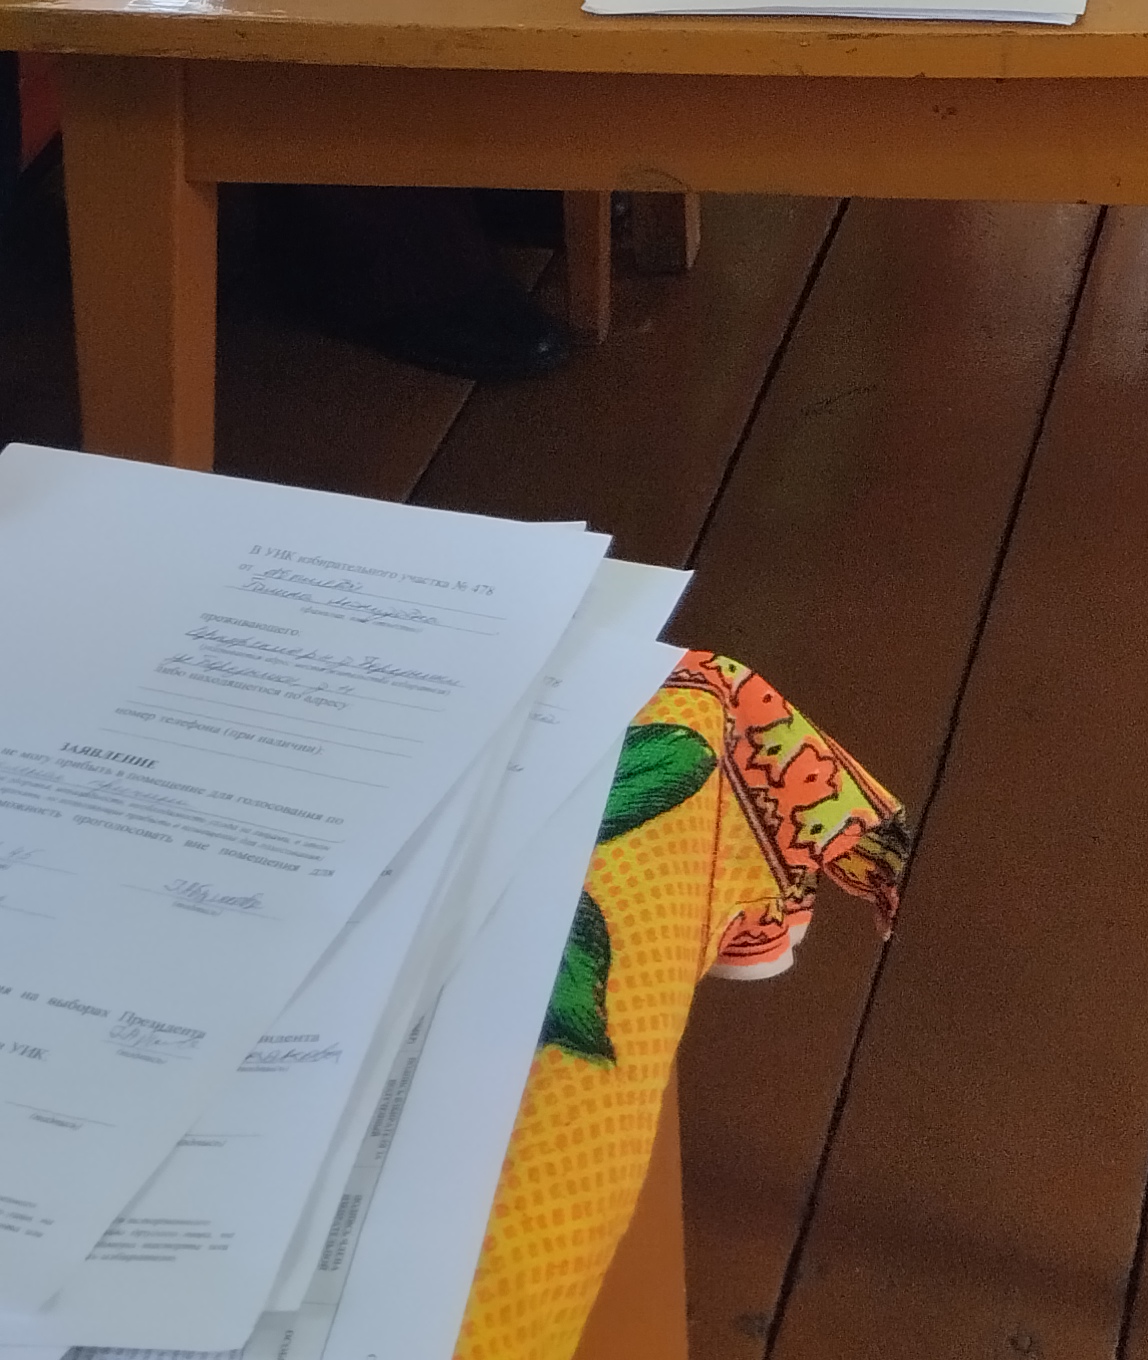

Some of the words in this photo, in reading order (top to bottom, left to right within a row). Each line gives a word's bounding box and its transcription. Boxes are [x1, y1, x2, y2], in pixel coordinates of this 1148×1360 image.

[249, 544, 262, 556] В
[264, 546, 297, 562] УИК
[298, 554, 398, 581] избирательного
[400, 572, 450, 590] участка
[471, 583, 496, 597] 478
[114, 706, 157, 722] номер
[159, 715, 222, 736] телефона
[224, 725, 256, 742] (при
[60, 742, 160, 770] ЗАЯВЛЕНИЕ
[1, 747, 19, 757] не
[19, 751, 52, 765] могу
[54, 757, 113, 776] прибыть
[126, 771, 207, 795] помещение
[206, 789, 235, 801] для
[236, 795, 325, 822] голосования
[325, 815, 345, 826] по
[72, 813, 175, 844] проголосовать
[183, 838, 211, 851] вне
[218, 847, 301, 872] помещения
[20, 989, 40, 1002] на
[46, 995, 111, 1019] выборах
[118, 1010, 207, 1040] Президента
[9, 1041, 50, 1062] УИК
